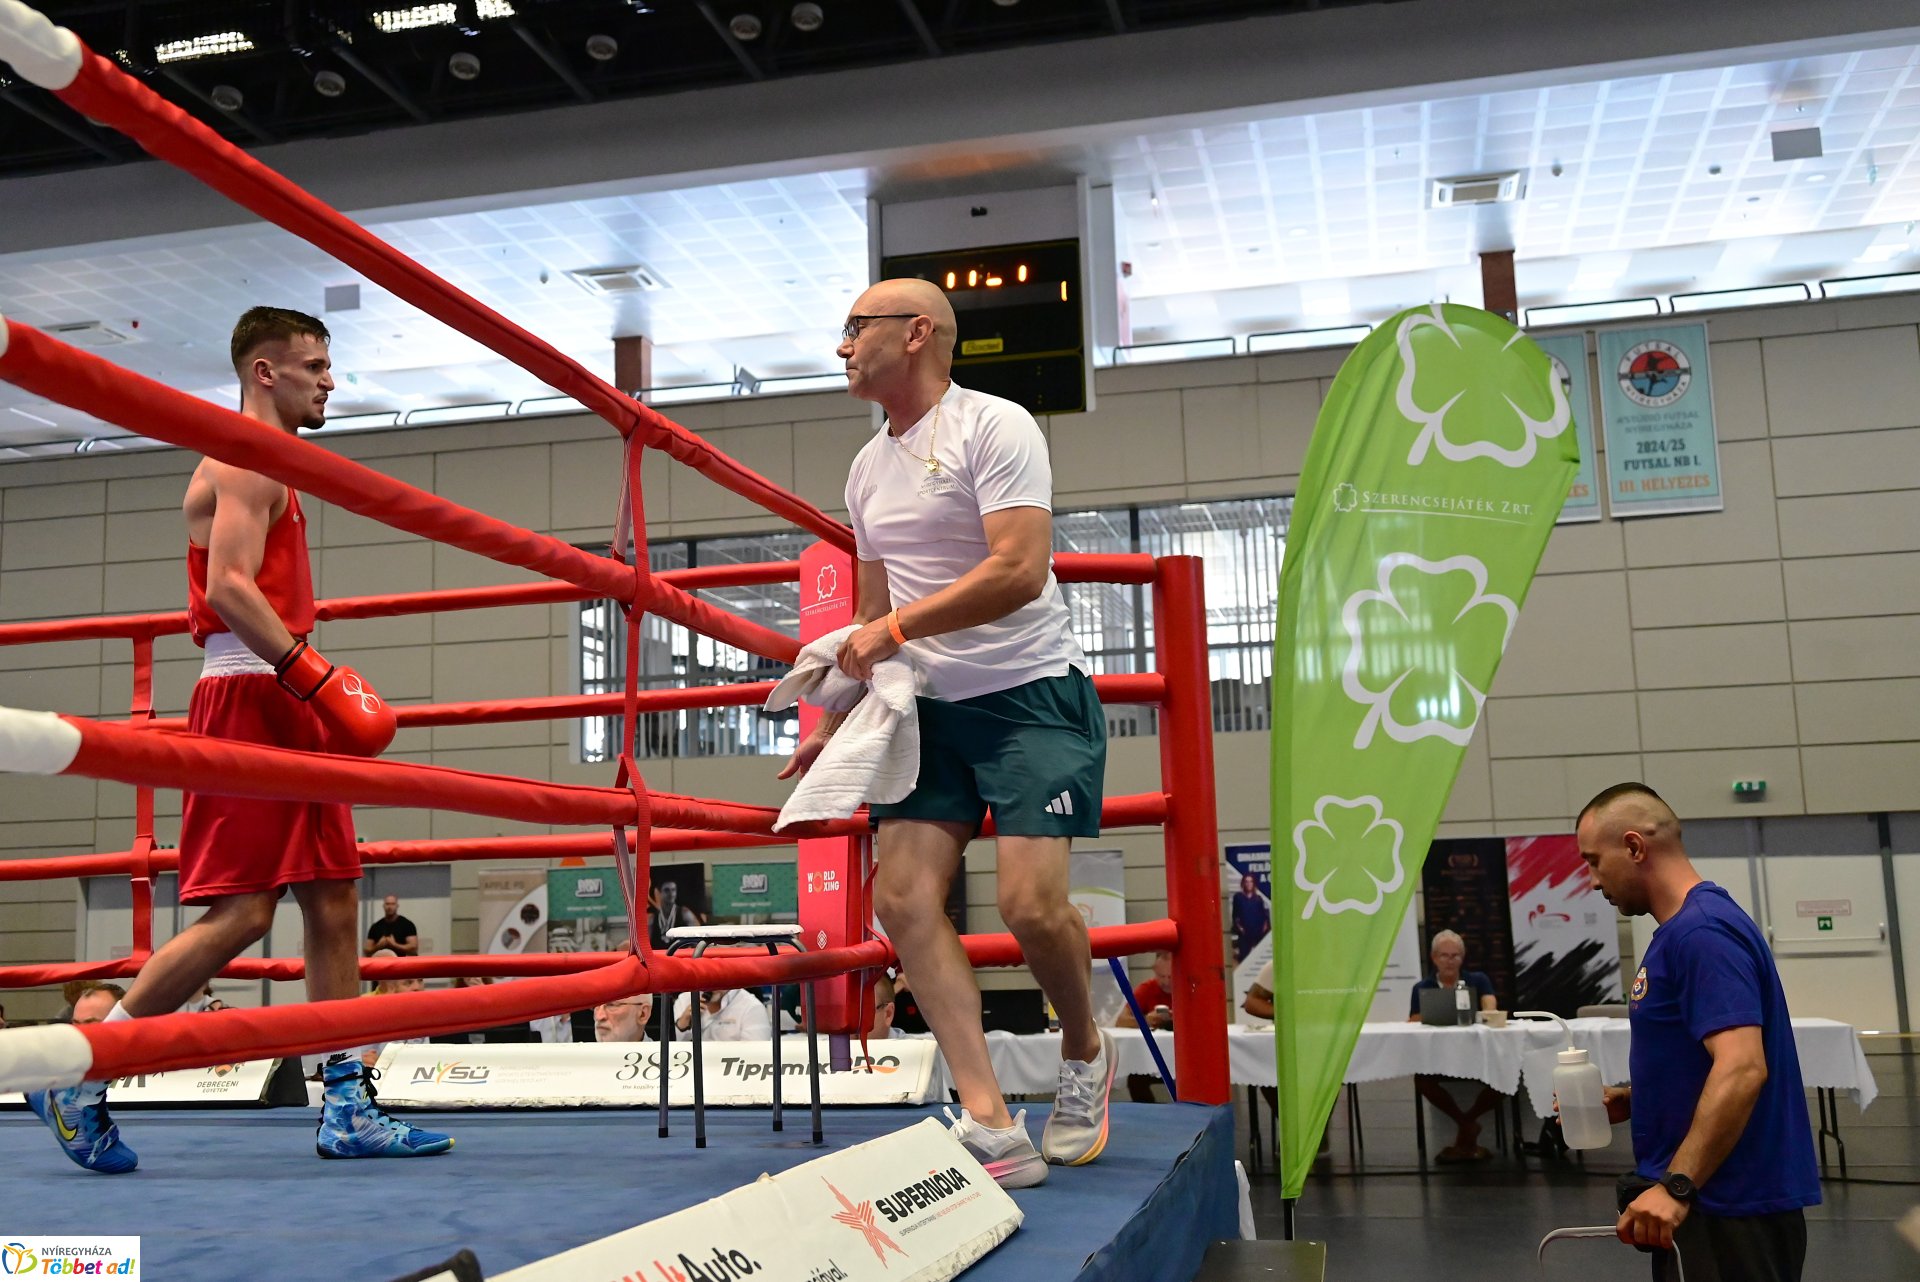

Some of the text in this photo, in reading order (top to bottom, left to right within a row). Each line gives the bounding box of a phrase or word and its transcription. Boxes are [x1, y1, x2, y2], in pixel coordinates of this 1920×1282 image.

[1624, 342, 1681, 363] FUTSAL
[1663, 411, 1699, 420] FUTSAL
[1637, 438, 1686, 454] 2024/25
[1624, 457, 1671, 471] FUTSAL
[1674, 455, 1690, 467] NB
[616, 1051, 692, 1080] 383
